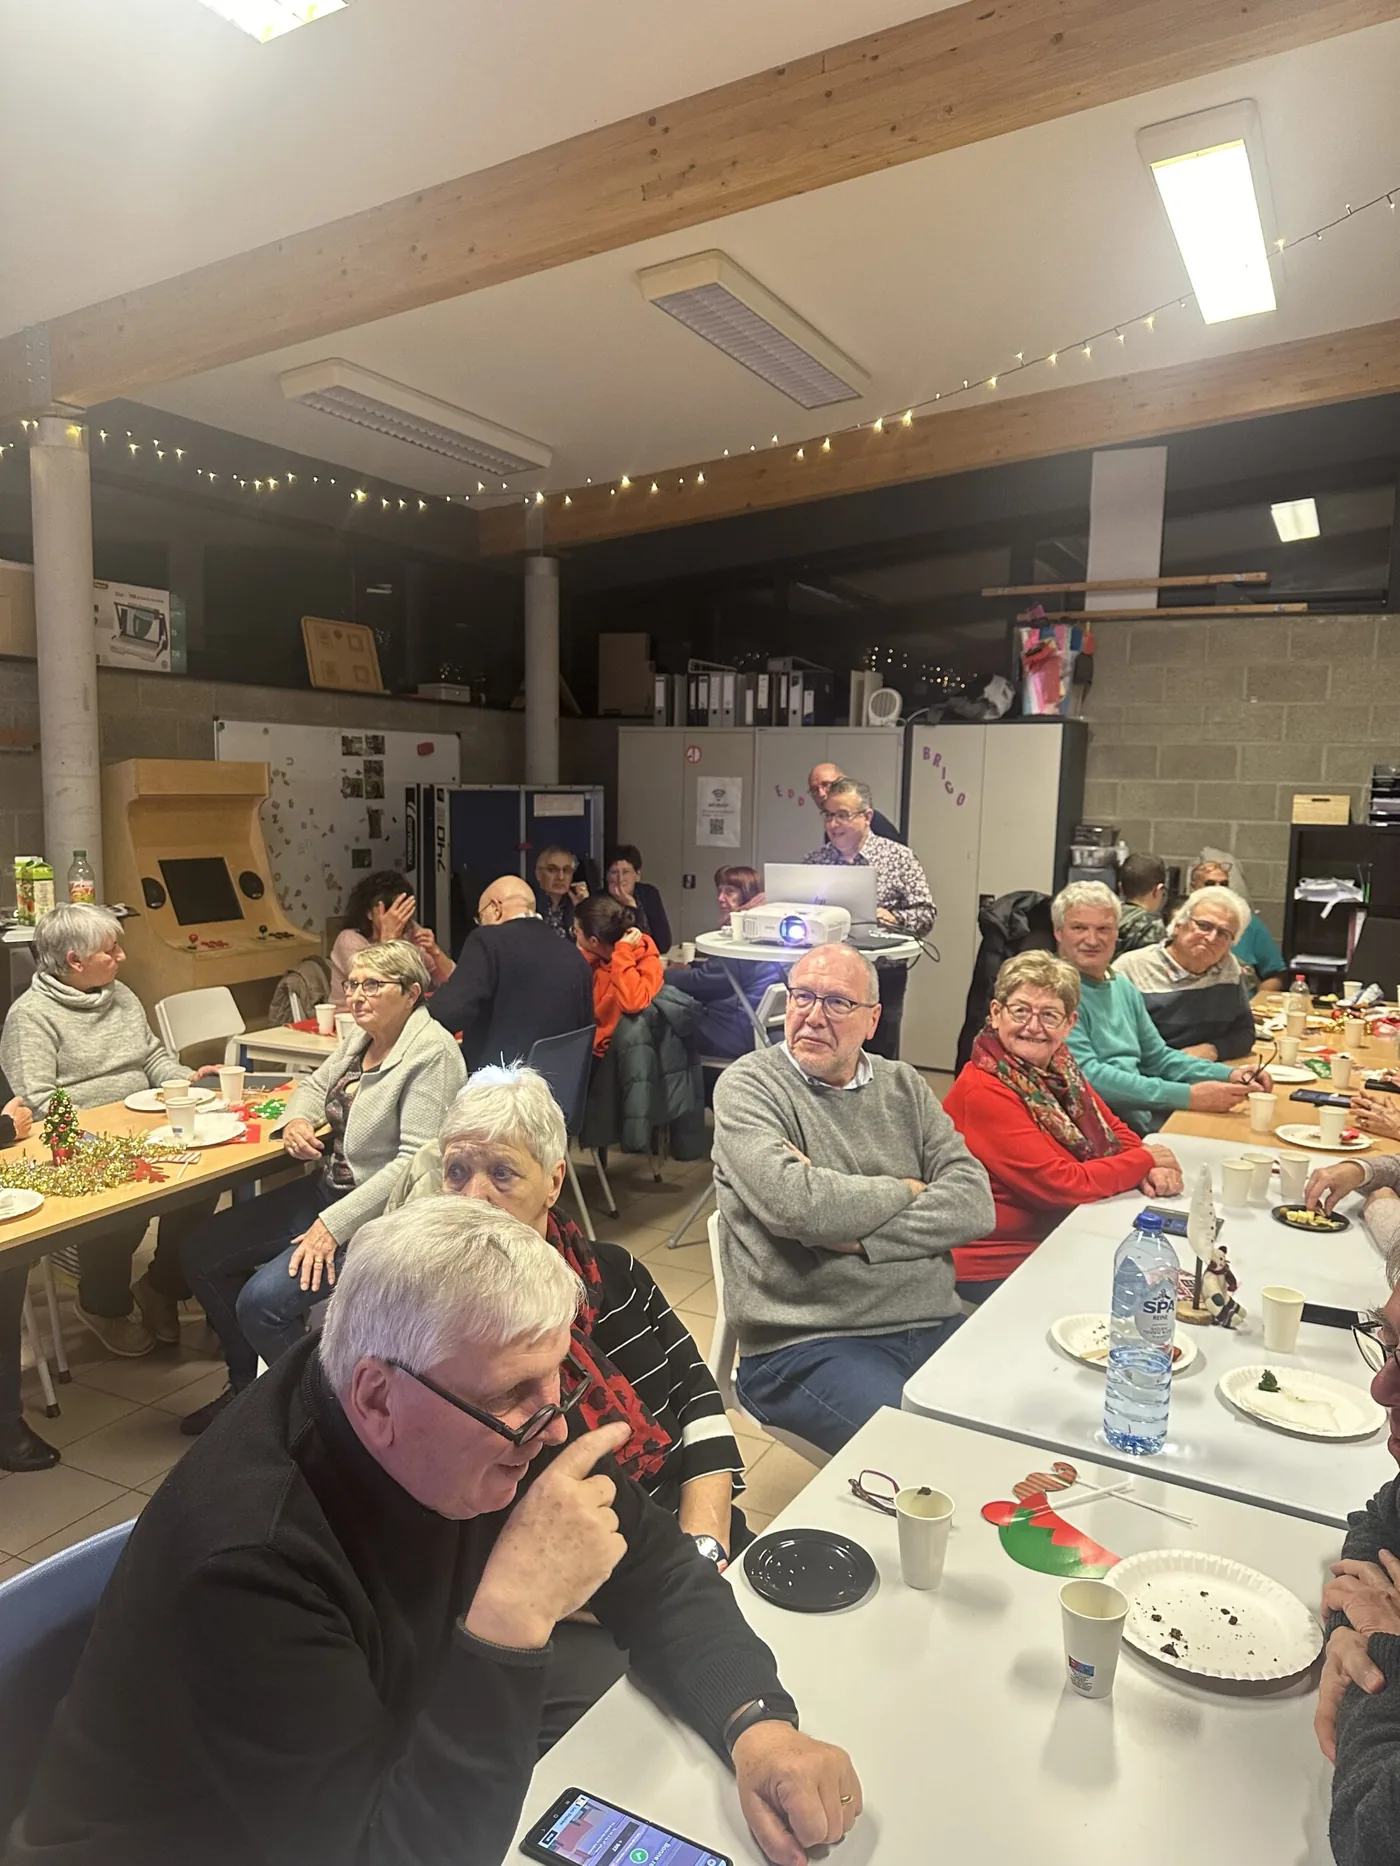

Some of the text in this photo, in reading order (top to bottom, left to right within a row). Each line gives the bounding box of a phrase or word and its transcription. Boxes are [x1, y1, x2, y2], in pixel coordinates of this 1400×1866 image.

[923, 746, 966, 807] BRICO
[437, 826, 445, 872] 740
[1143, 1300, 1174, 1313] SPA
